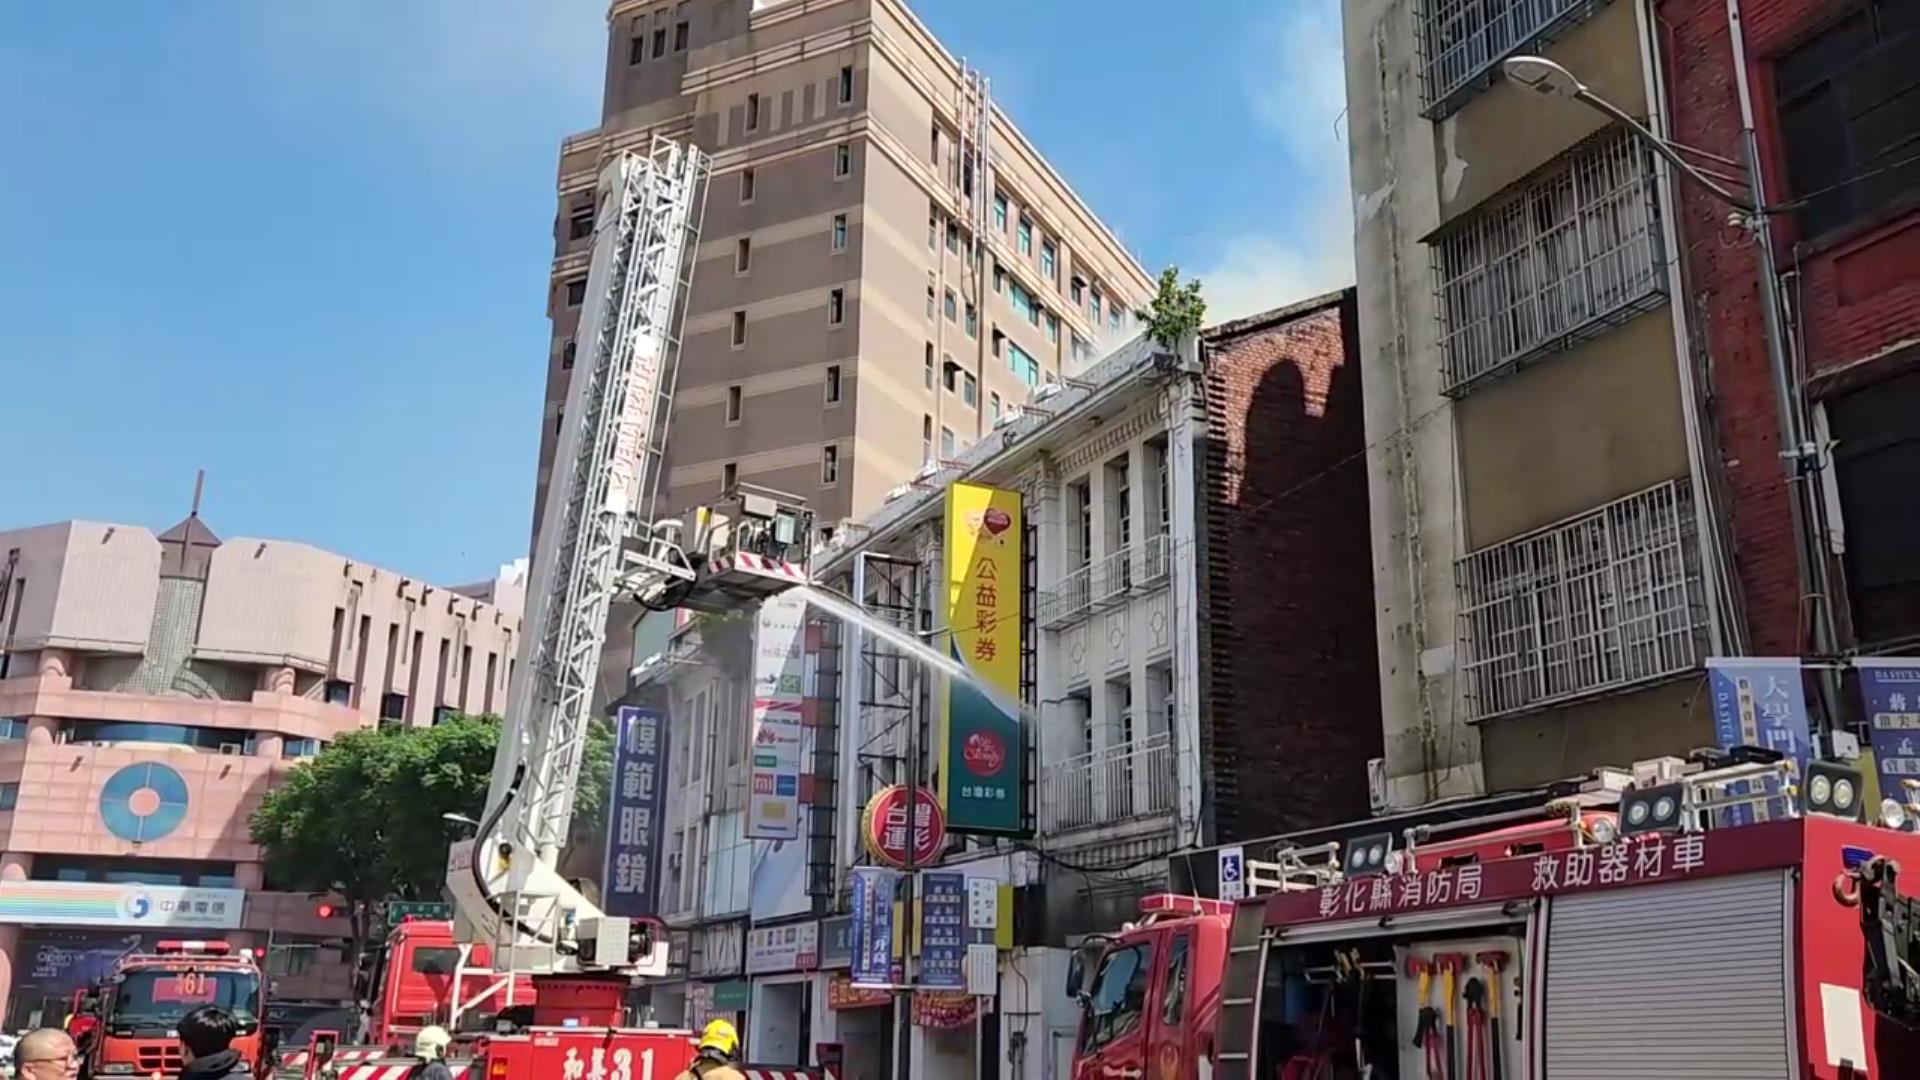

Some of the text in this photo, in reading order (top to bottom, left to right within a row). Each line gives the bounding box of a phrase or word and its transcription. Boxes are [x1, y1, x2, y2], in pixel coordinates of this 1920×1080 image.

[975, 556, 998, 662] 公益彩券
[1762, 676, 1798, 780] 大學門
[614, 715, 657, 894] 模範眼鏡
[160, 900, 225, 915] 中華電信
[1319, 834, 1706, 918] 彰化縣消防局 救助器材車
